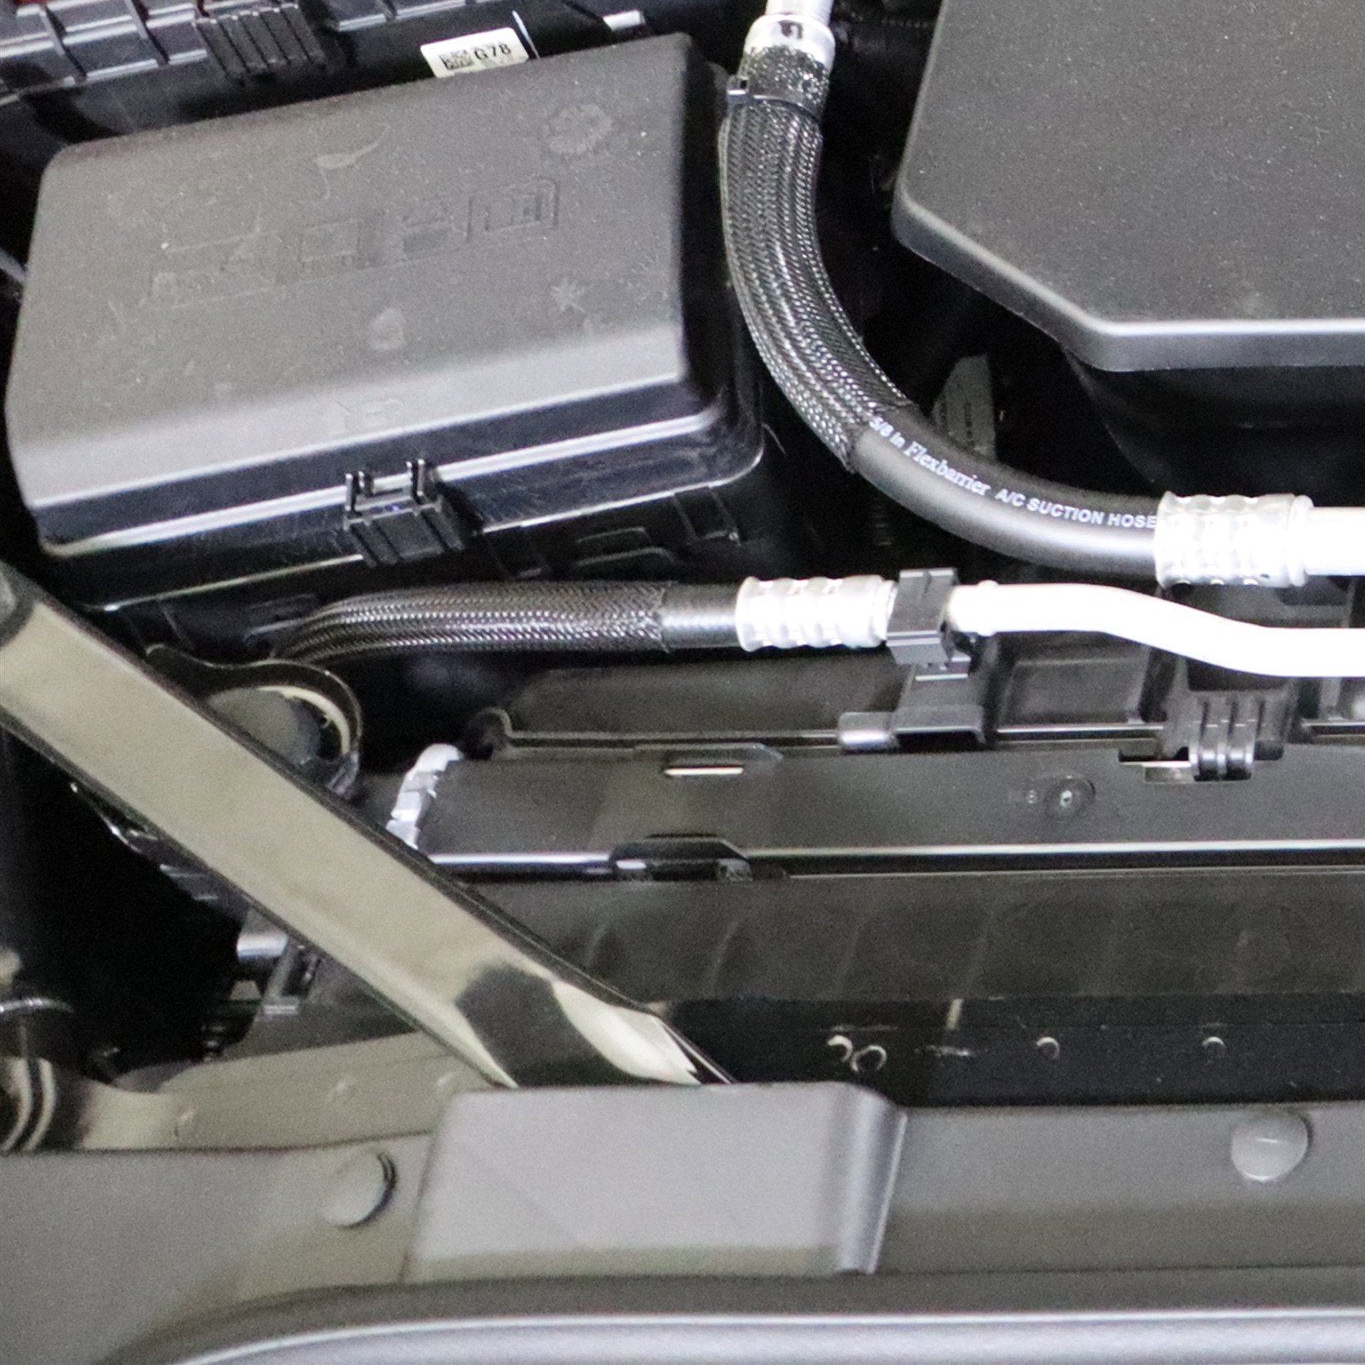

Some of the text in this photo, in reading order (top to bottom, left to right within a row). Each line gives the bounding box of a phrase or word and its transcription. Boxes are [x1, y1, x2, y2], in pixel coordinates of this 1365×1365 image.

[868, 416, 1157, 529] 5/8 in Flexbarrier A/C SUCTION HOSE
